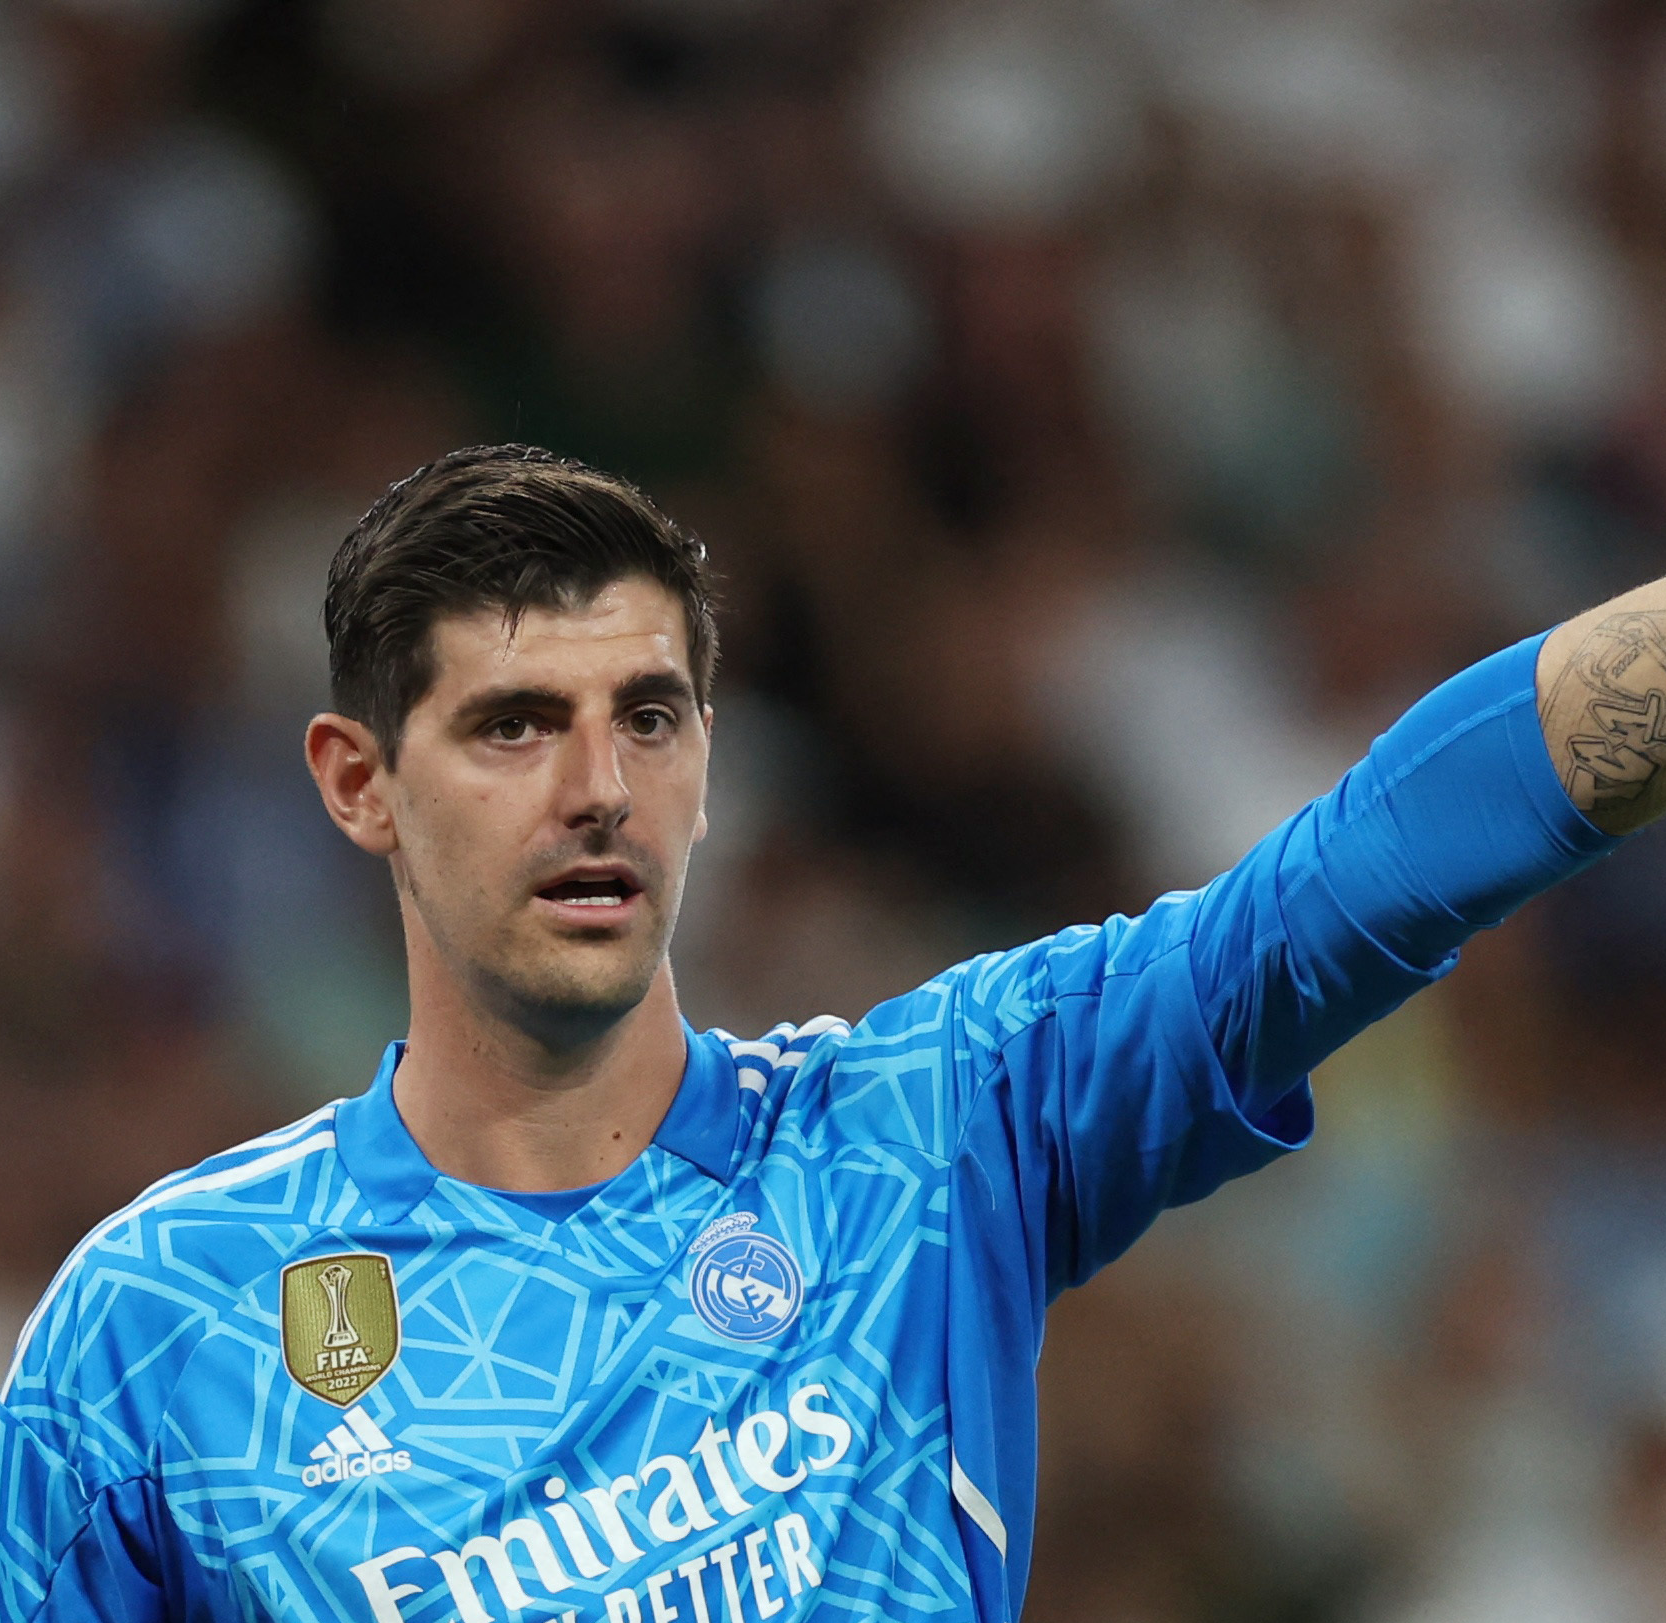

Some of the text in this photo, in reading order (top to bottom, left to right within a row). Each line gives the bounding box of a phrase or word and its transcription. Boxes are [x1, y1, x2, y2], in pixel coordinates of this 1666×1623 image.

[316, 1347, 369, 1372] FIFA
[305, 1364, 382, 1383] WORLD CHAMPIONS
[328, 1375, 359, 1390] 2022
[301, 1450, 413, 1488] adidas
